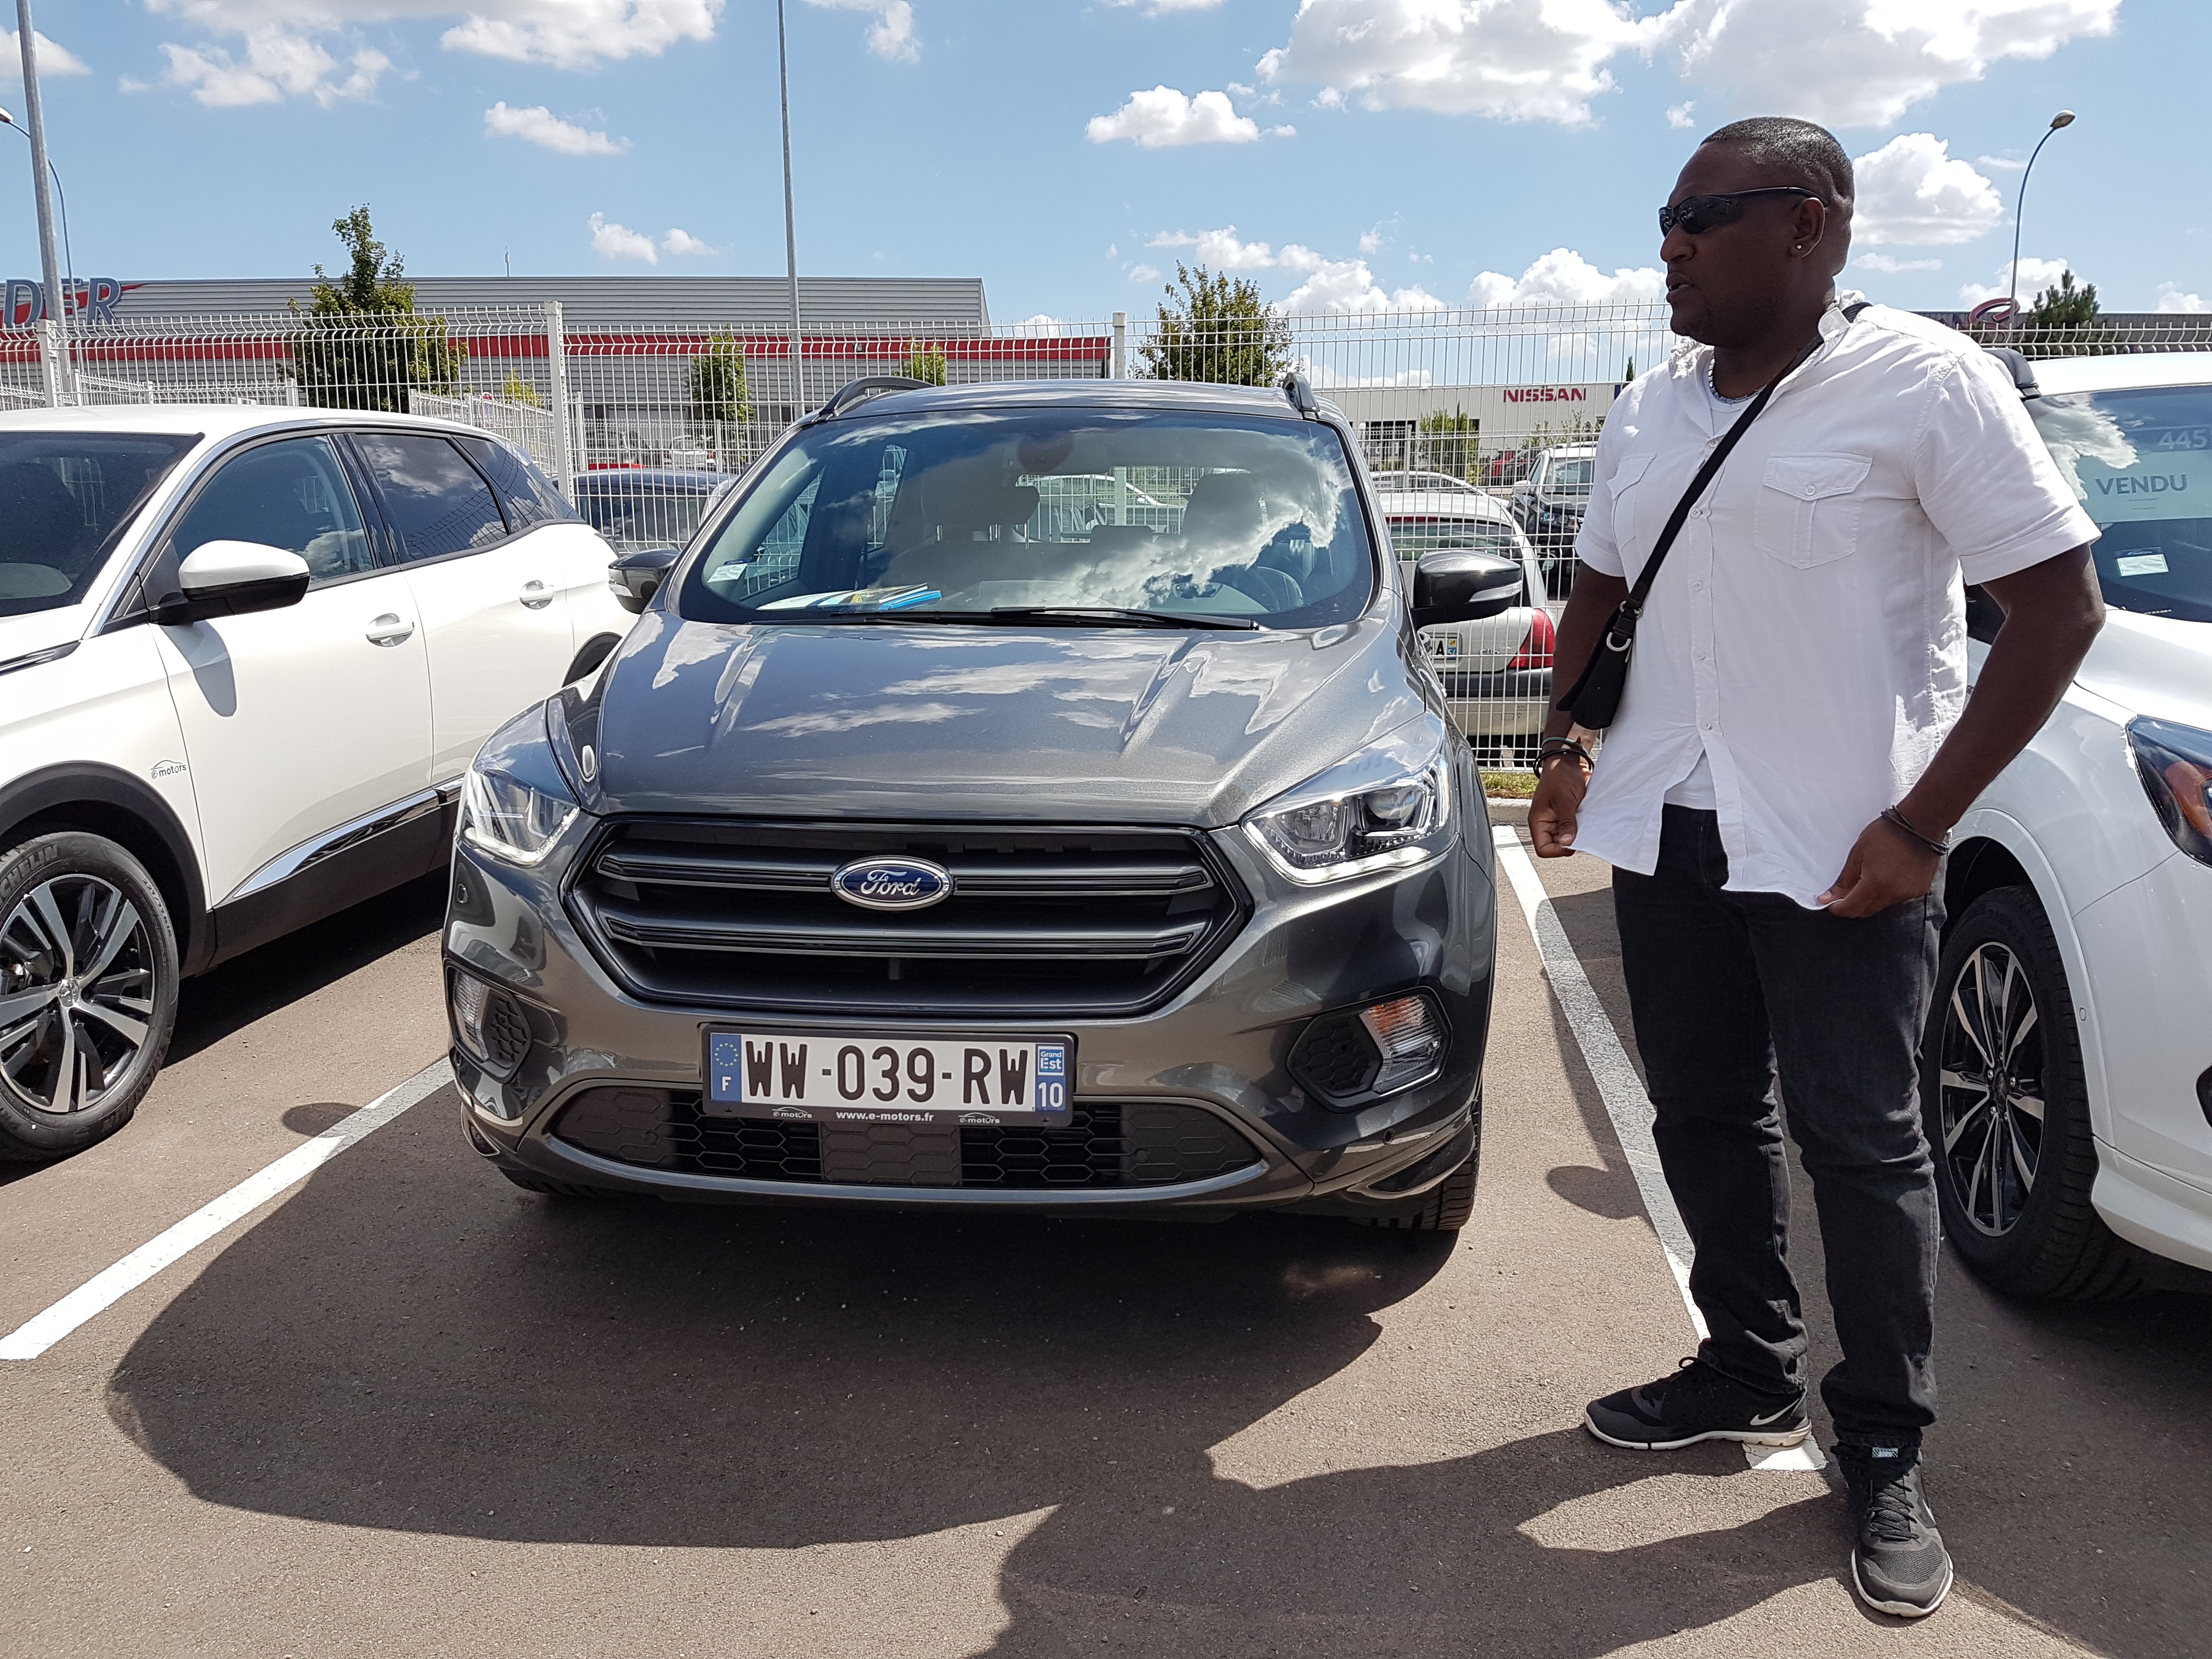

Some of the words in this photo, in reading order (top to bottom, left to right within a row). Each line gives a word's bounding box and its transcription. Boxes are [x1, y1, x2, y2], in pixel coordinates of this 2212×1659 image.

[1503, 388, 1587, 403] NISSAN
[2158, 428, 2212, 449] 445
[2095, 474, 2188, 495] VENDU
[0, 844, 58, 903] CHELIN
[860, 869, 922, 895] Ford
[1040, 1057, 1062, 1070] Est
[721, 1076, 732, 1092] F
[1038, 1082, 1064, 1108] 10
[836, 1111, 934, 1122] www.e-motors.fr
